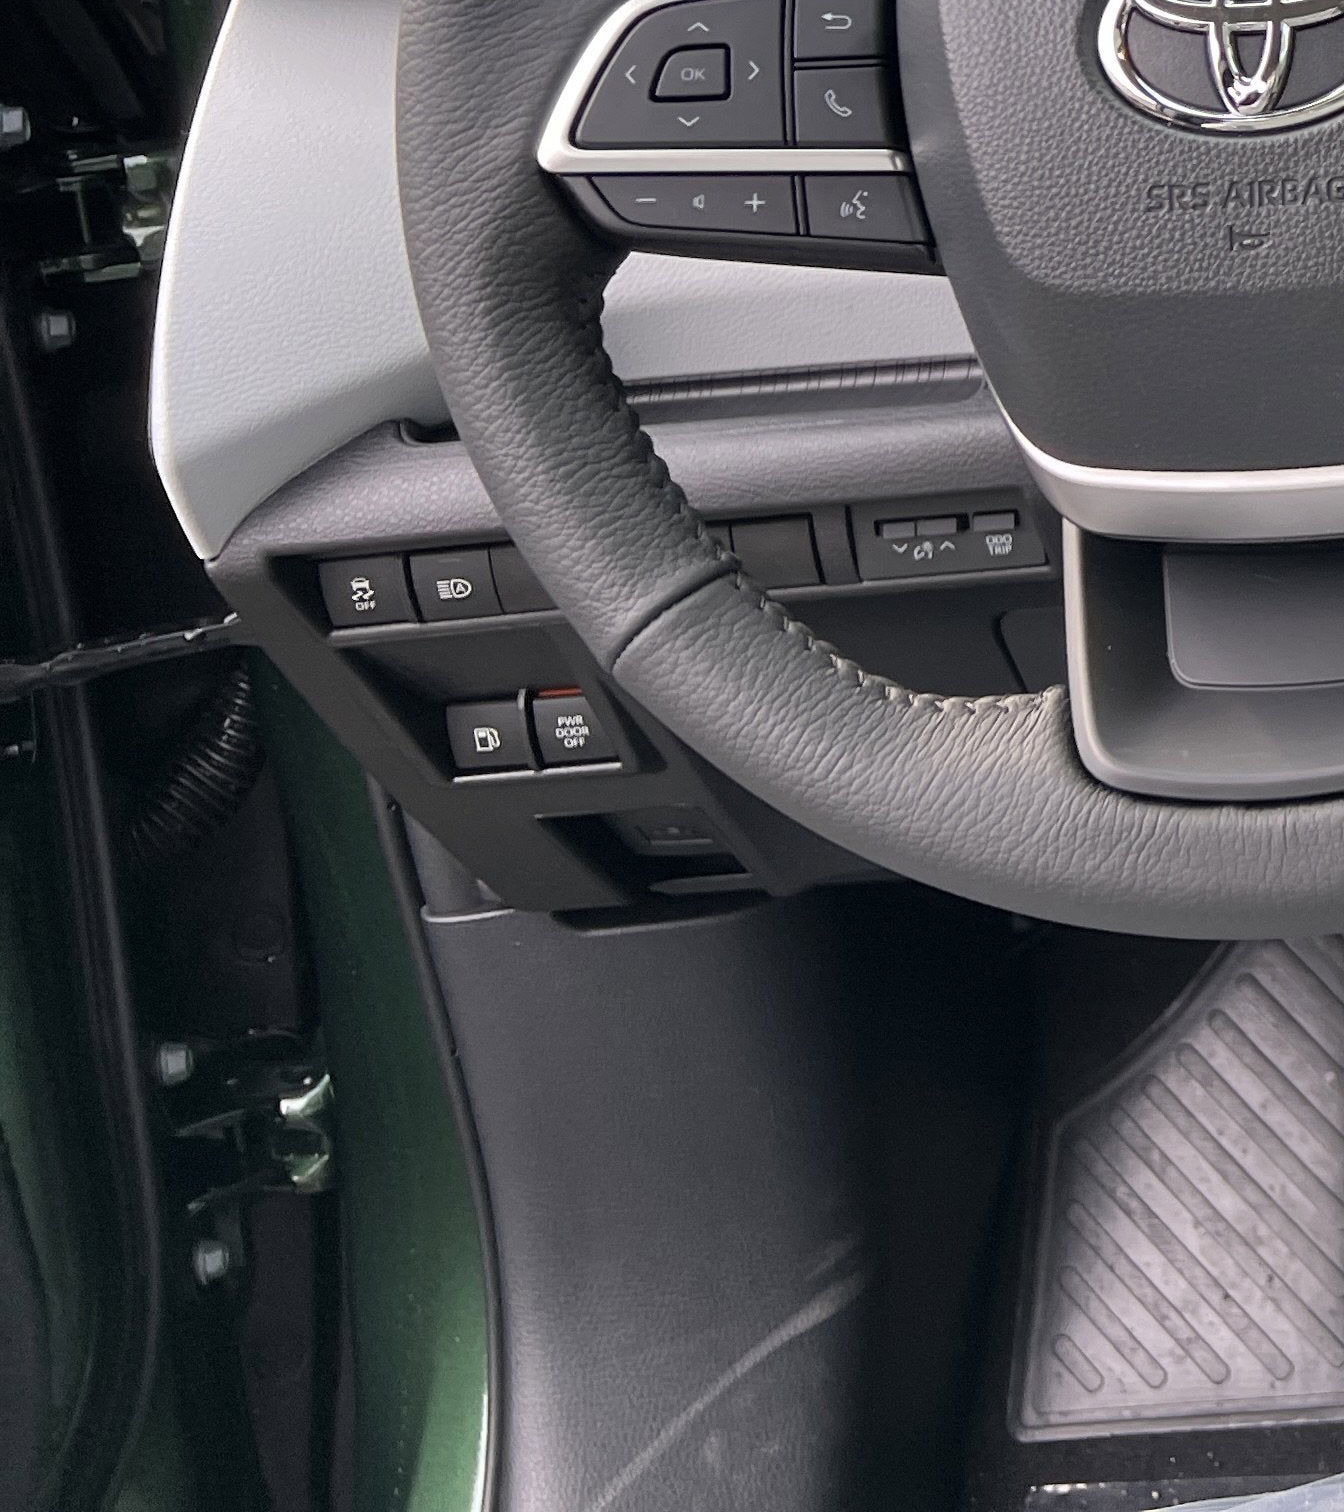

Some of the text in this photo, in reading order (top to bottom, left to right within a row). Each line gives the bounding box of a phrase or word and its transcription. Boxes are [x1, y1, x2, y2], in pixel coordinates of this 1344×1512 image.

[681, 68, 705, 81] OK
[1146, 182, 1210, 213] SRS
[987, 544, 1012, 556] TRIP
[355, 600, 376, 611] OFF
[557, 715, 584, 727] PWR
[555, 725, 590, 738] DOOR
[564, 737, 586, 749] OFF
